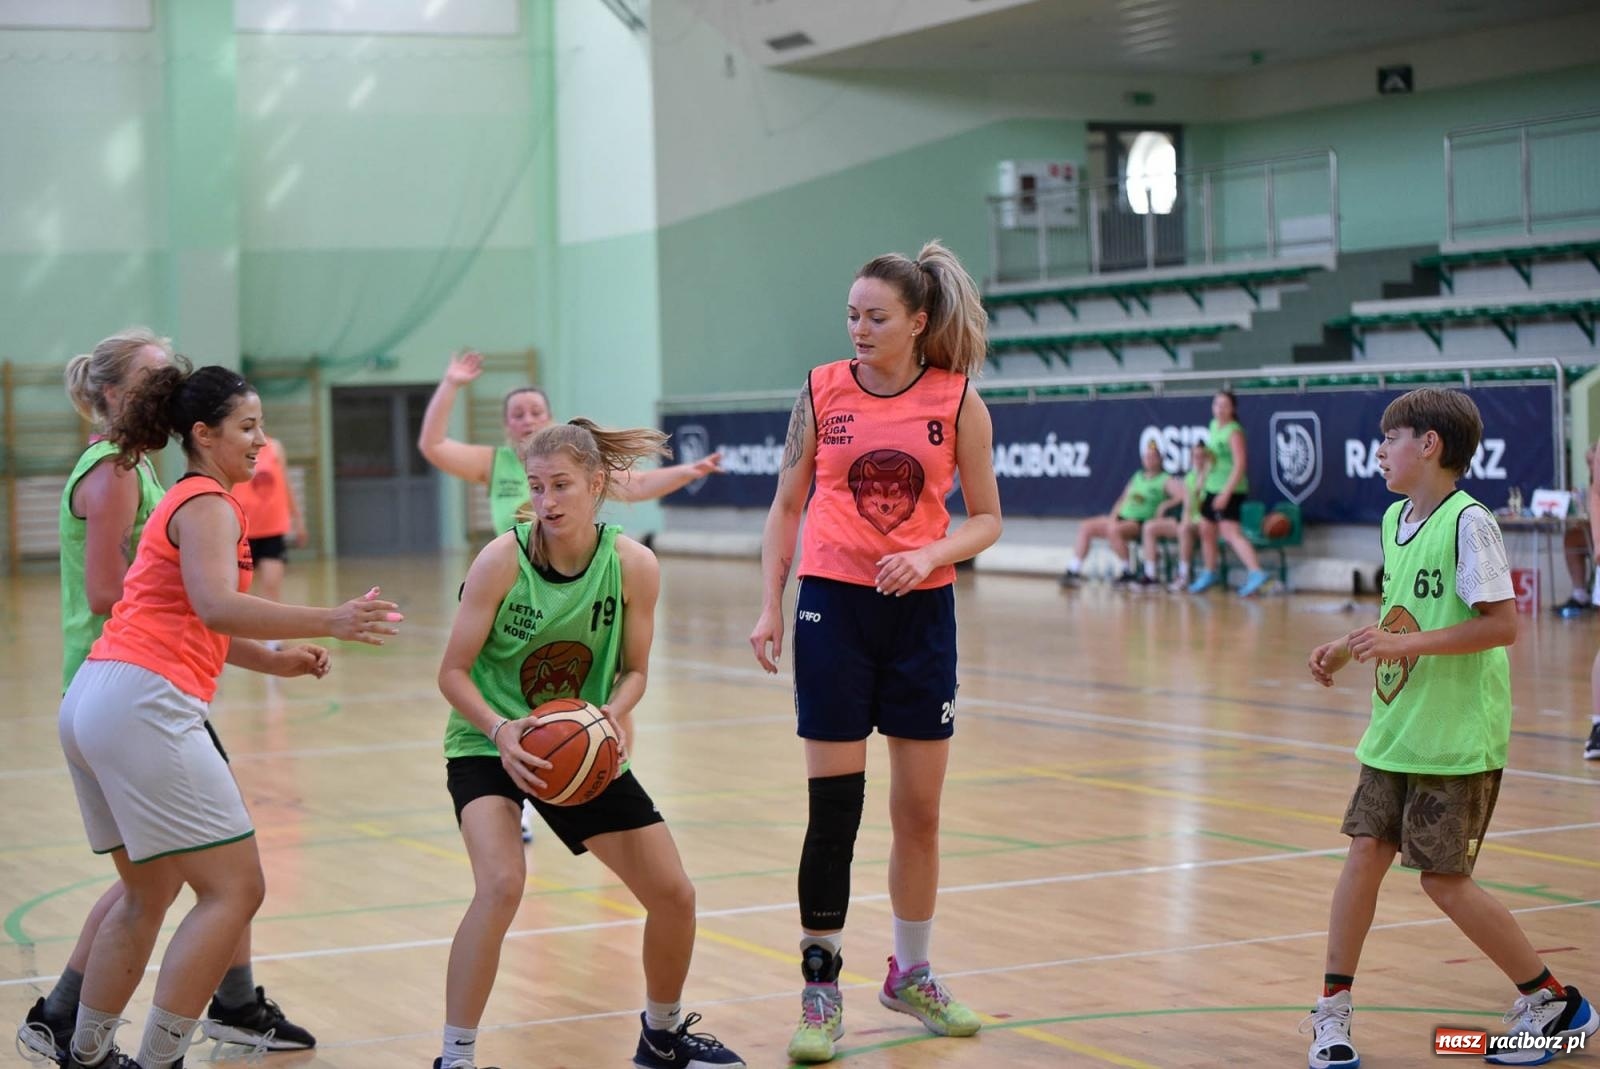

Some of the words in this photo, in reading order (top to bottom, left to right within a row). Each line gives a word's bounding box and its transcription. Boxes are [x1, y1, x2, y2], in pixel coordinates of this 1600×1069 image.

[927, 420, 944, 446] 8
[991, 431, 1091, 477] ACIBÓRZ
[1413, 568, 1444, 599] 63
[591, 595, 617, 632] 19
